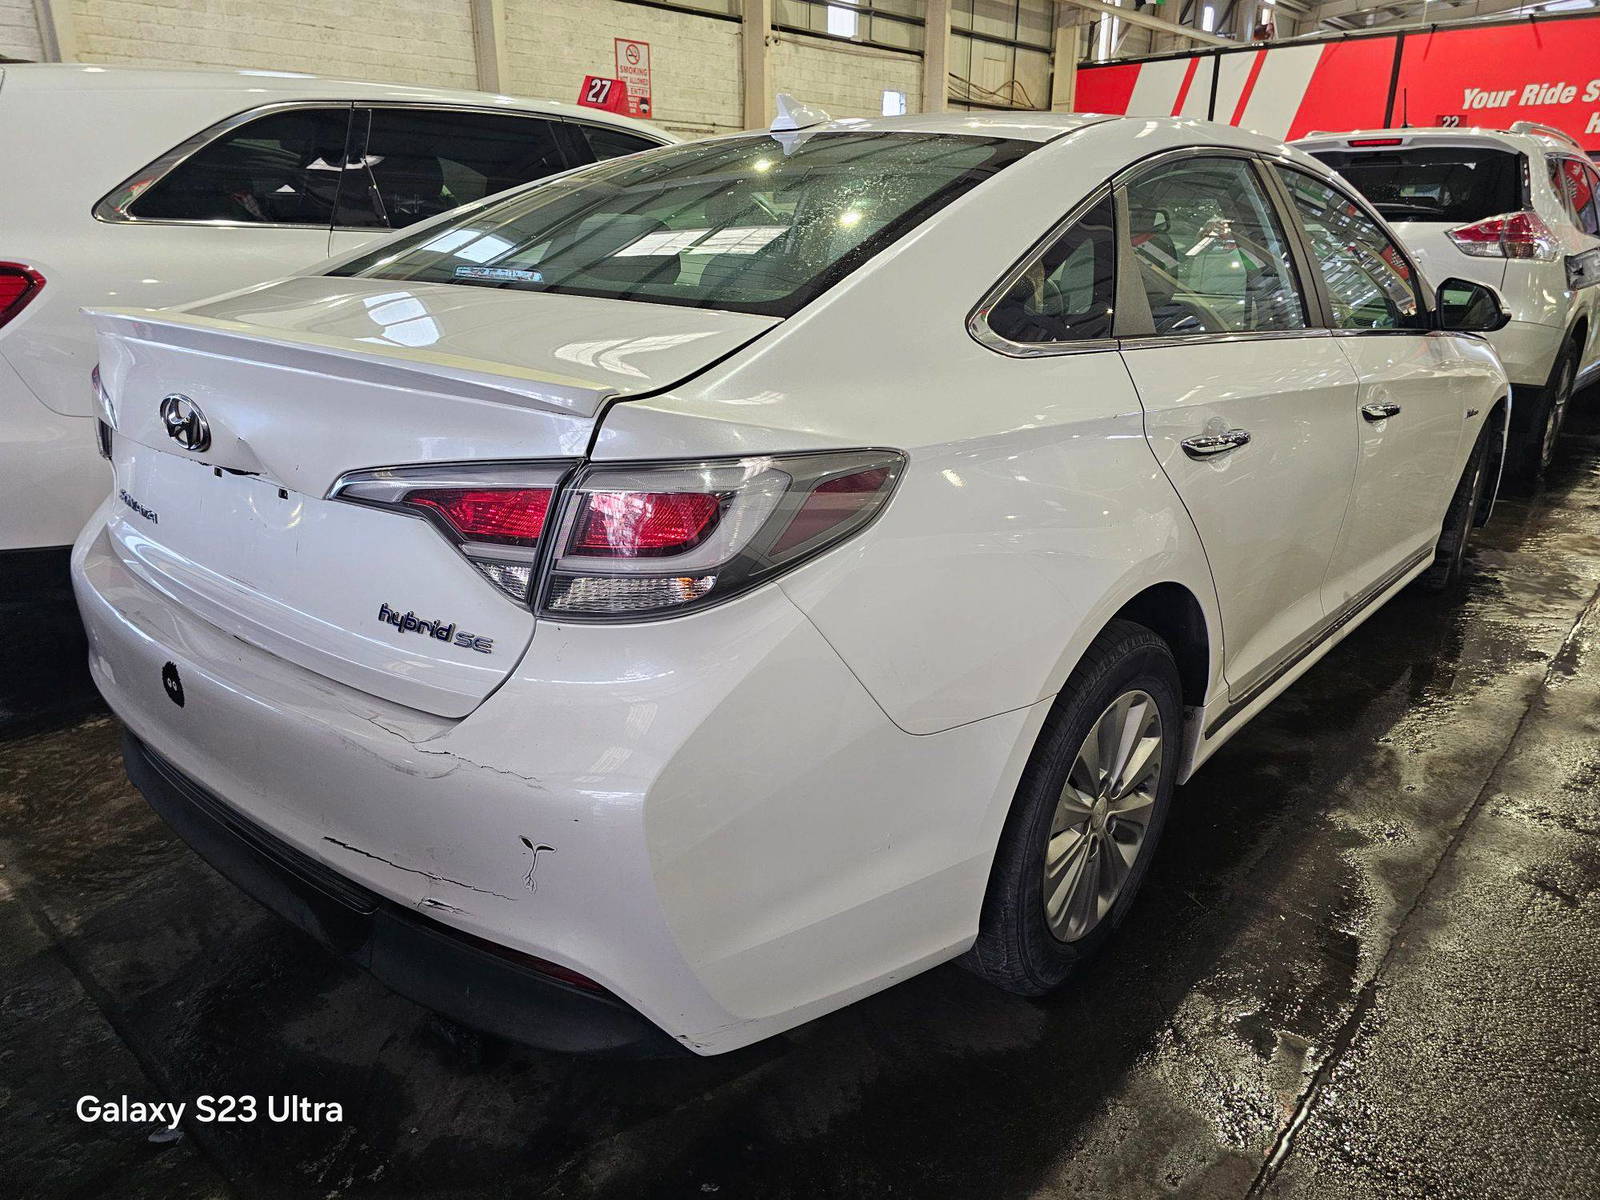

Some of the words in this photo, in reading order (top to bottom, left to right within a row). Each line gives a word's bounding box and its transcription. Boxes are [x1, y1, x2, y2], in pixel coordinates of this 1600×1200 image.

[620, 65, 648, 77] SMOKING
[587, 78, 612, 103] 27
[1462, 88, 1516, 110] Your
[1518, 82, 1577, 106] Ride
[1442, 116, 1459, 128] 22
[378, 602, 457, 642] hybrid
[454, 630, 494, 654] SE
